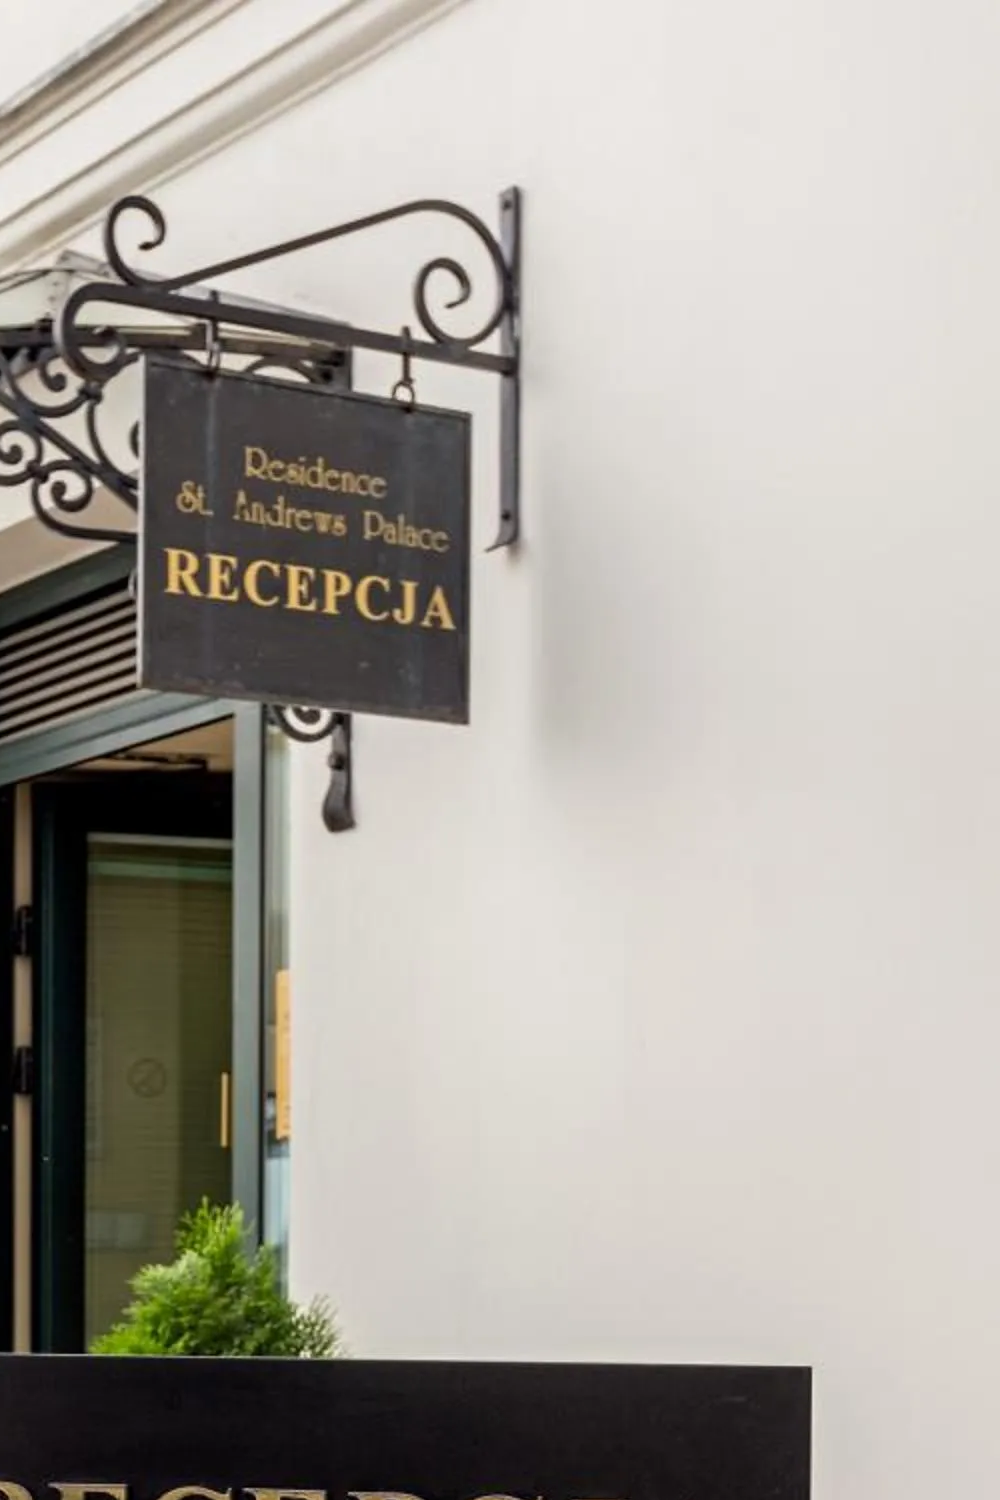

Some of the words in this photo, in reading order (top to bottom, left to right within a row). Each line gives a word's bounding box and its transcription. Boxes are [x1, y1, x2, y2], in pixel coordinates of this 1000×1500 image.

[244, 446, 387, 499] Residence
[232, 488, 347, 537] Andrews
[362, 510, 451, 553] Palace
[163, 547, 457, 630] RECEPCJA
